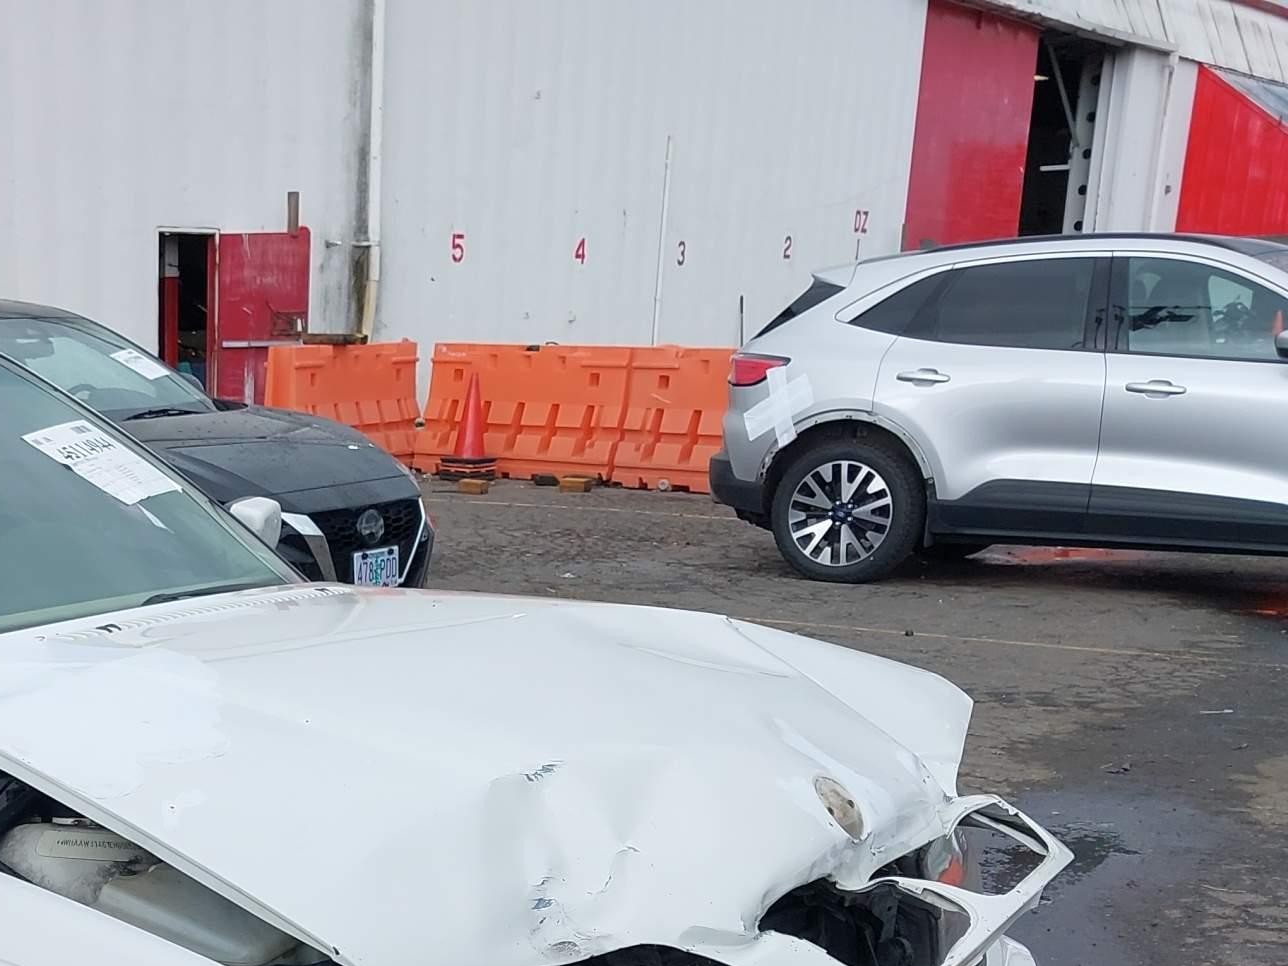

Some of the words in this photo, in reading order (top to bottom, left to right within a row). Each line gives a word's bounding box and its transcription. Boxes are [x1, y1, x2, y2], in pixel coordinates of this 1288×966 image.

[854, 210, 869, 234] DZ
[451, 233, 465, 263] 5
[574, 237, 586, 265] 4
[676, 240, 687, 267] 3
[782, 235, 793, 260] 2
